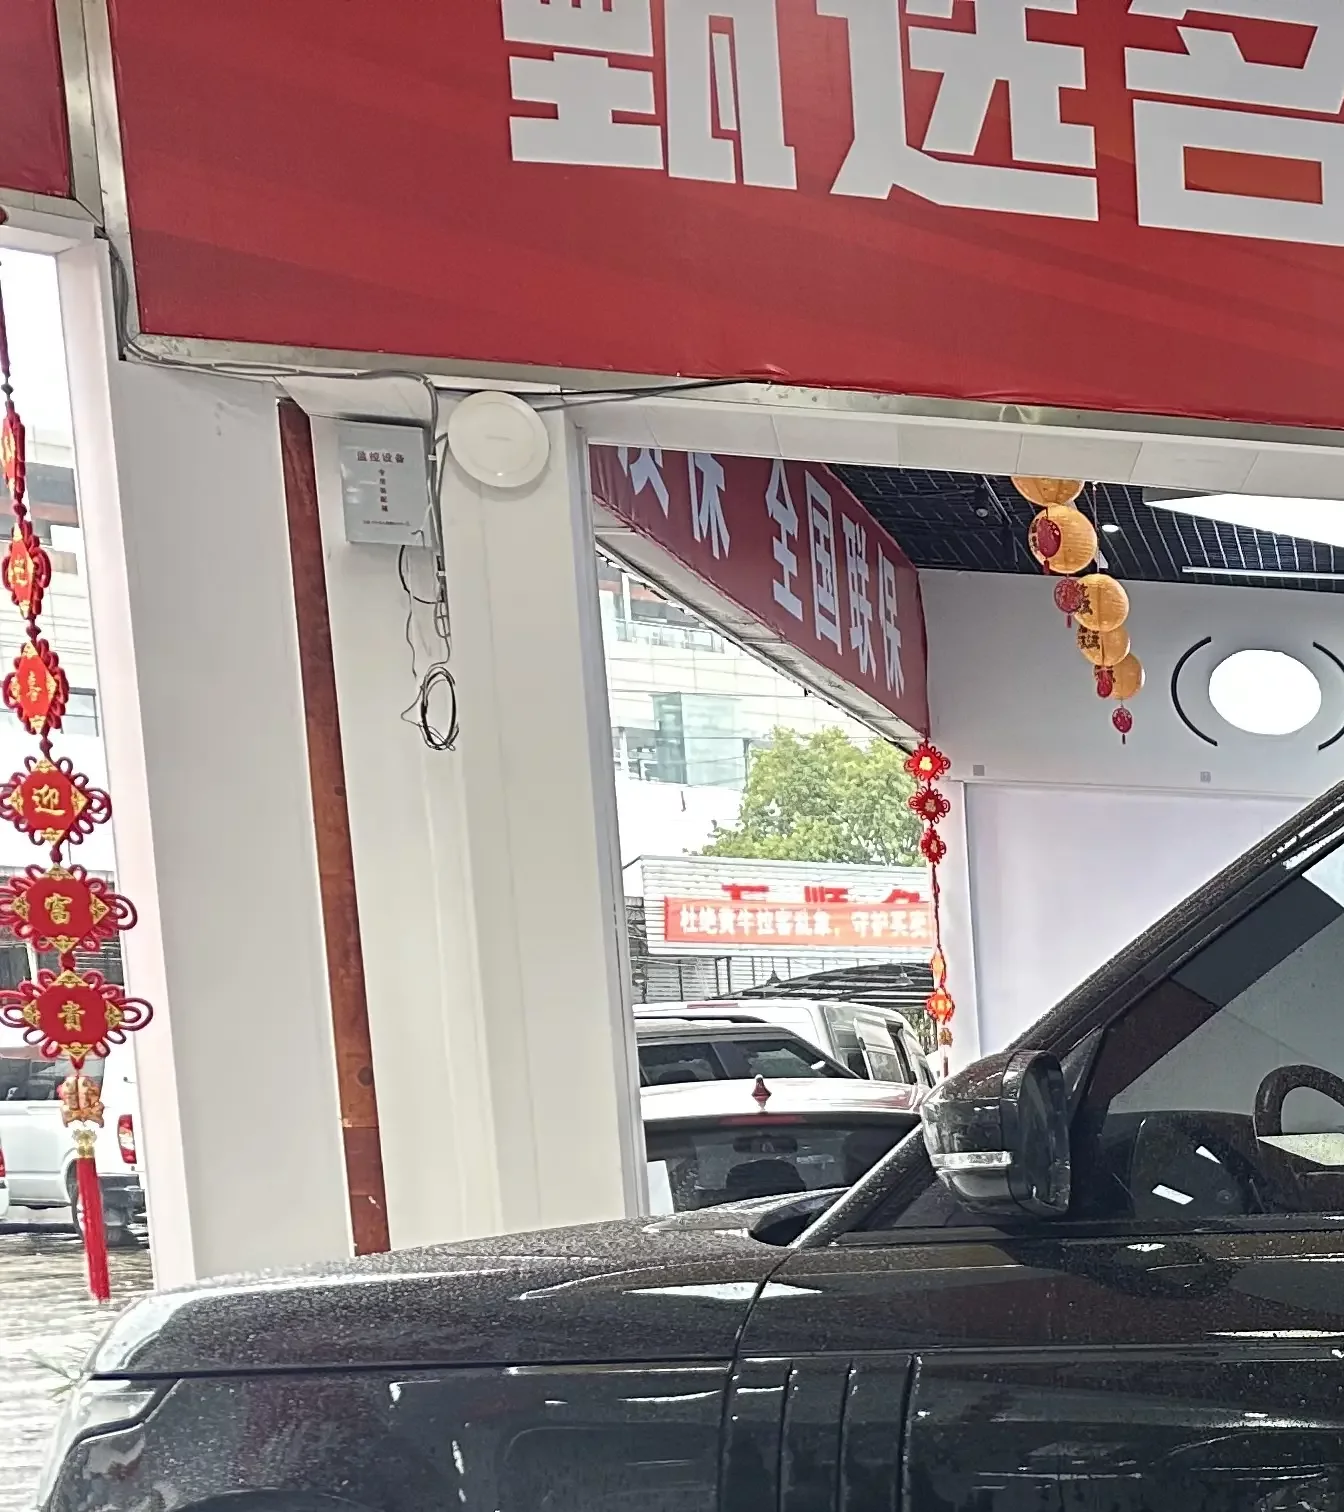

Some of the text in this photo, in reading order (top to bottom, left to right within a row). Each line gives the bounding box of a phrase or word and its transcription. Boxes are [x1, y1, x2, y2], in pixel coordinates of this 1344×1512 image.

[765, 459, 905, 699] 全国联保
[31, 783, 66, 816] 迎
[44, 892, 73, 925] 富
